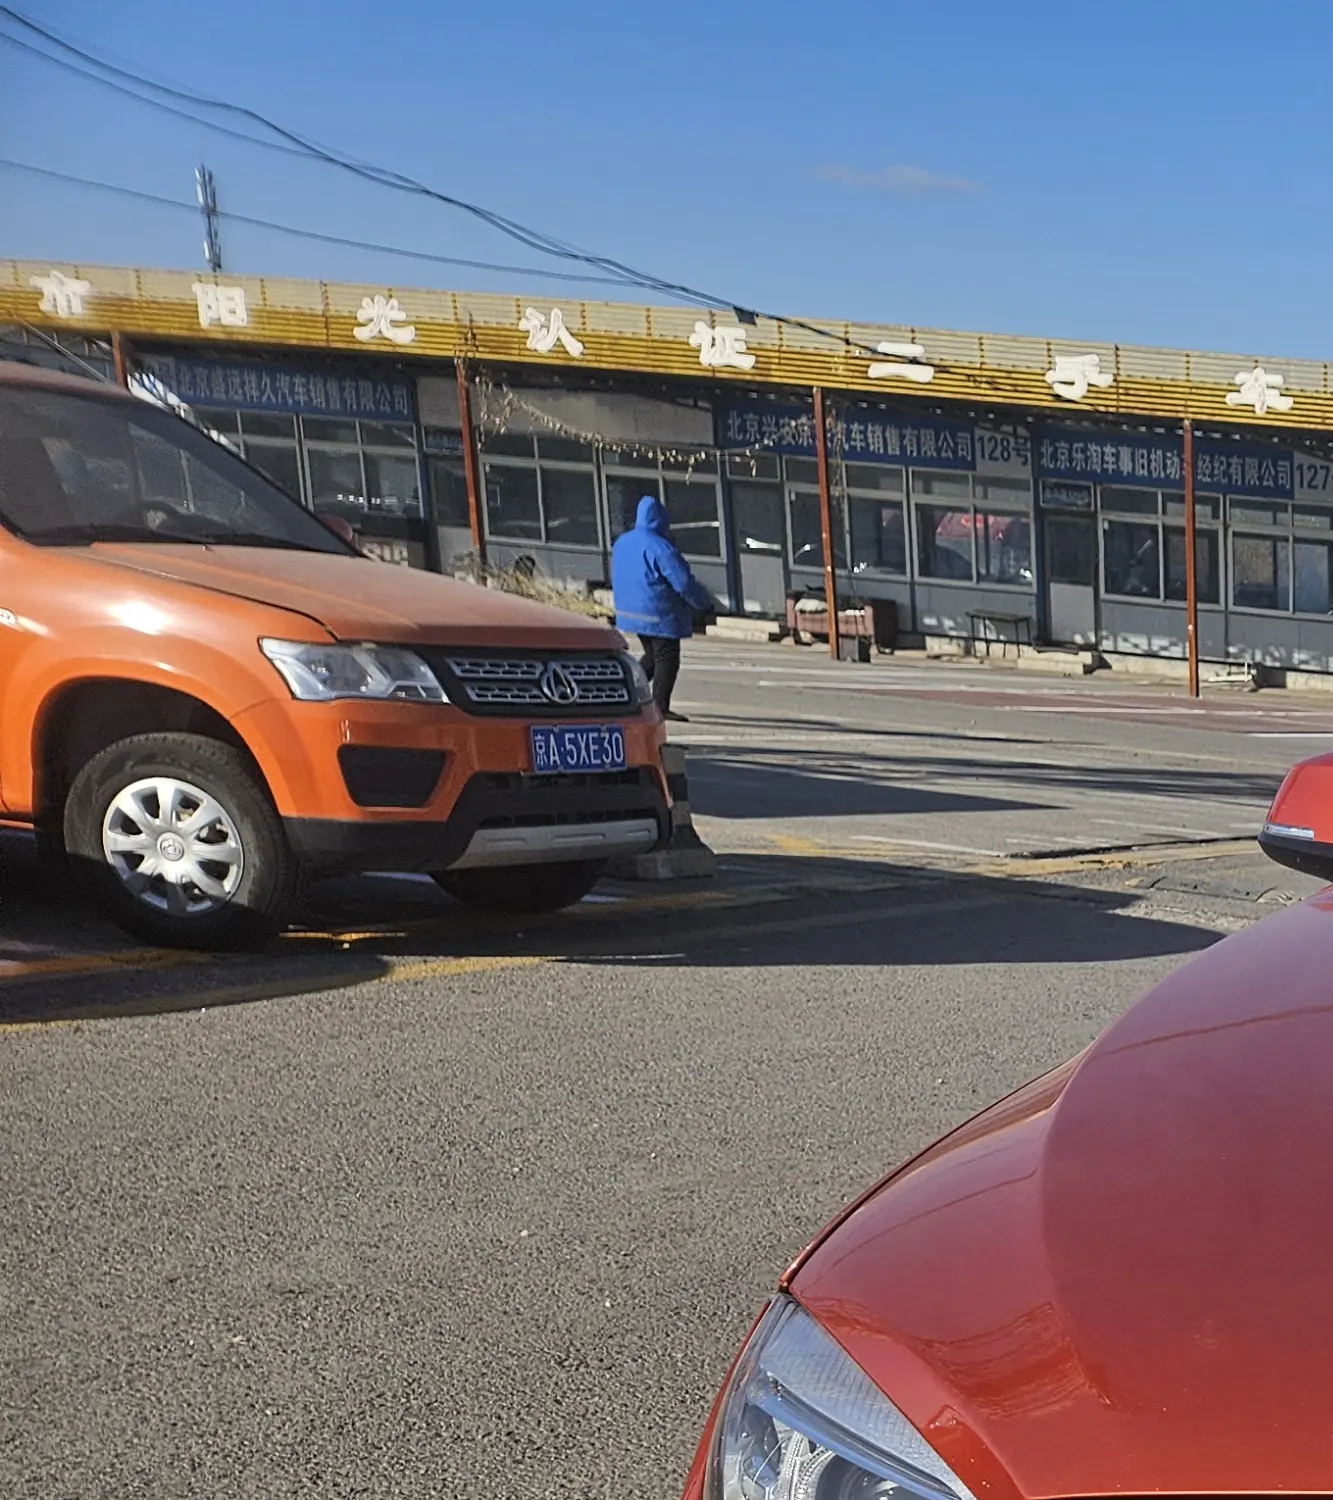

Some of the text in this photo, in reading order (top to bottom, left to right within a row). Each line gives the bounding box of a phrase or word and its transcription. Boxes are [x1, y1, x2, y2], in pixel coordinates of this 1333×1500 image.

[1040, 439, 1292, 488] 北京乐淘车事旧机动经纪有限公司
